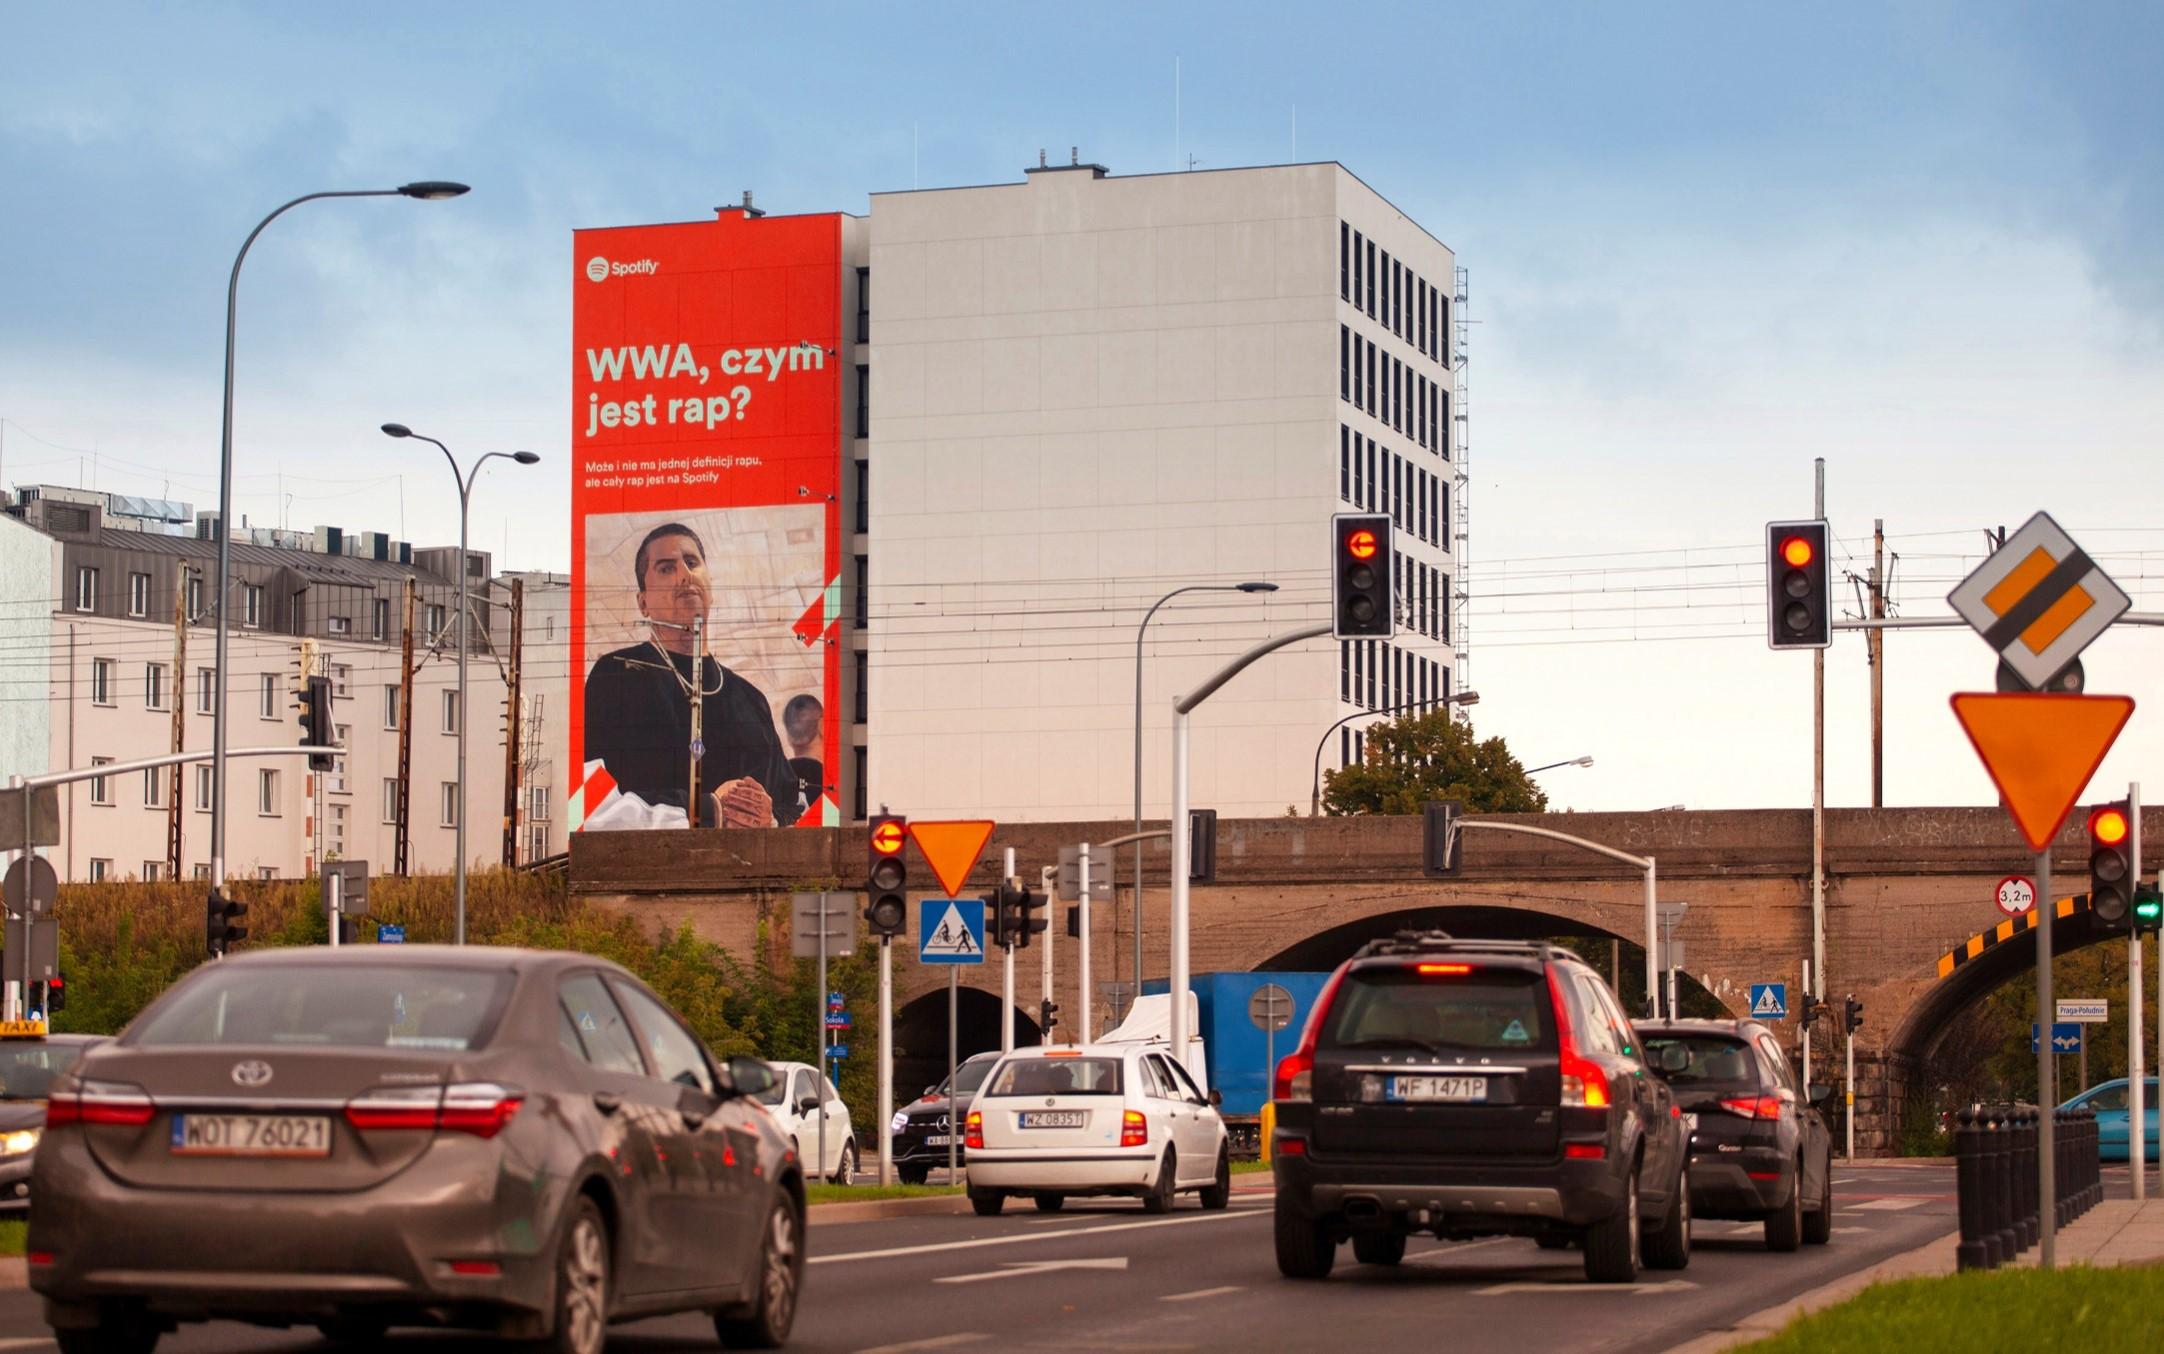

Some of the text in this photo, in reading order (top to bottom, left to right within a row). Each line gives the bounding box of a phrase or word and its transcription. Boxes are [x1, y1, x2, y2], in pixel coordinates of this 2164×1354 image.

[611, 259, 659, 277] Spotify
[586, 343, 824, 384] WWA, czym
[585, 385, 752, 438] jest rap?
[585, 462, 614, 472] Może
[622, 460, 638, 471] nie
[640, 461, 656, 470] ma
[658, 457, 690, 472] jednej
[692, 455, 733, 469] definicji
[735, 456, 762, 468] rapu.
[585, 470, 719, 489] ale cały rap jest na Spotify
[2060, 1006, 2105, 1016] Praga-Południe
[4, 1022, 38, 1032] TAXI
[1381, 1055, 1490, 1064] VOLVO
[1396, 1079, 1484, 1097] WF 1471P
[1026, 1113, 1042, 1125] WZ
[187, 1117, 326, 1146] WOT 76021
